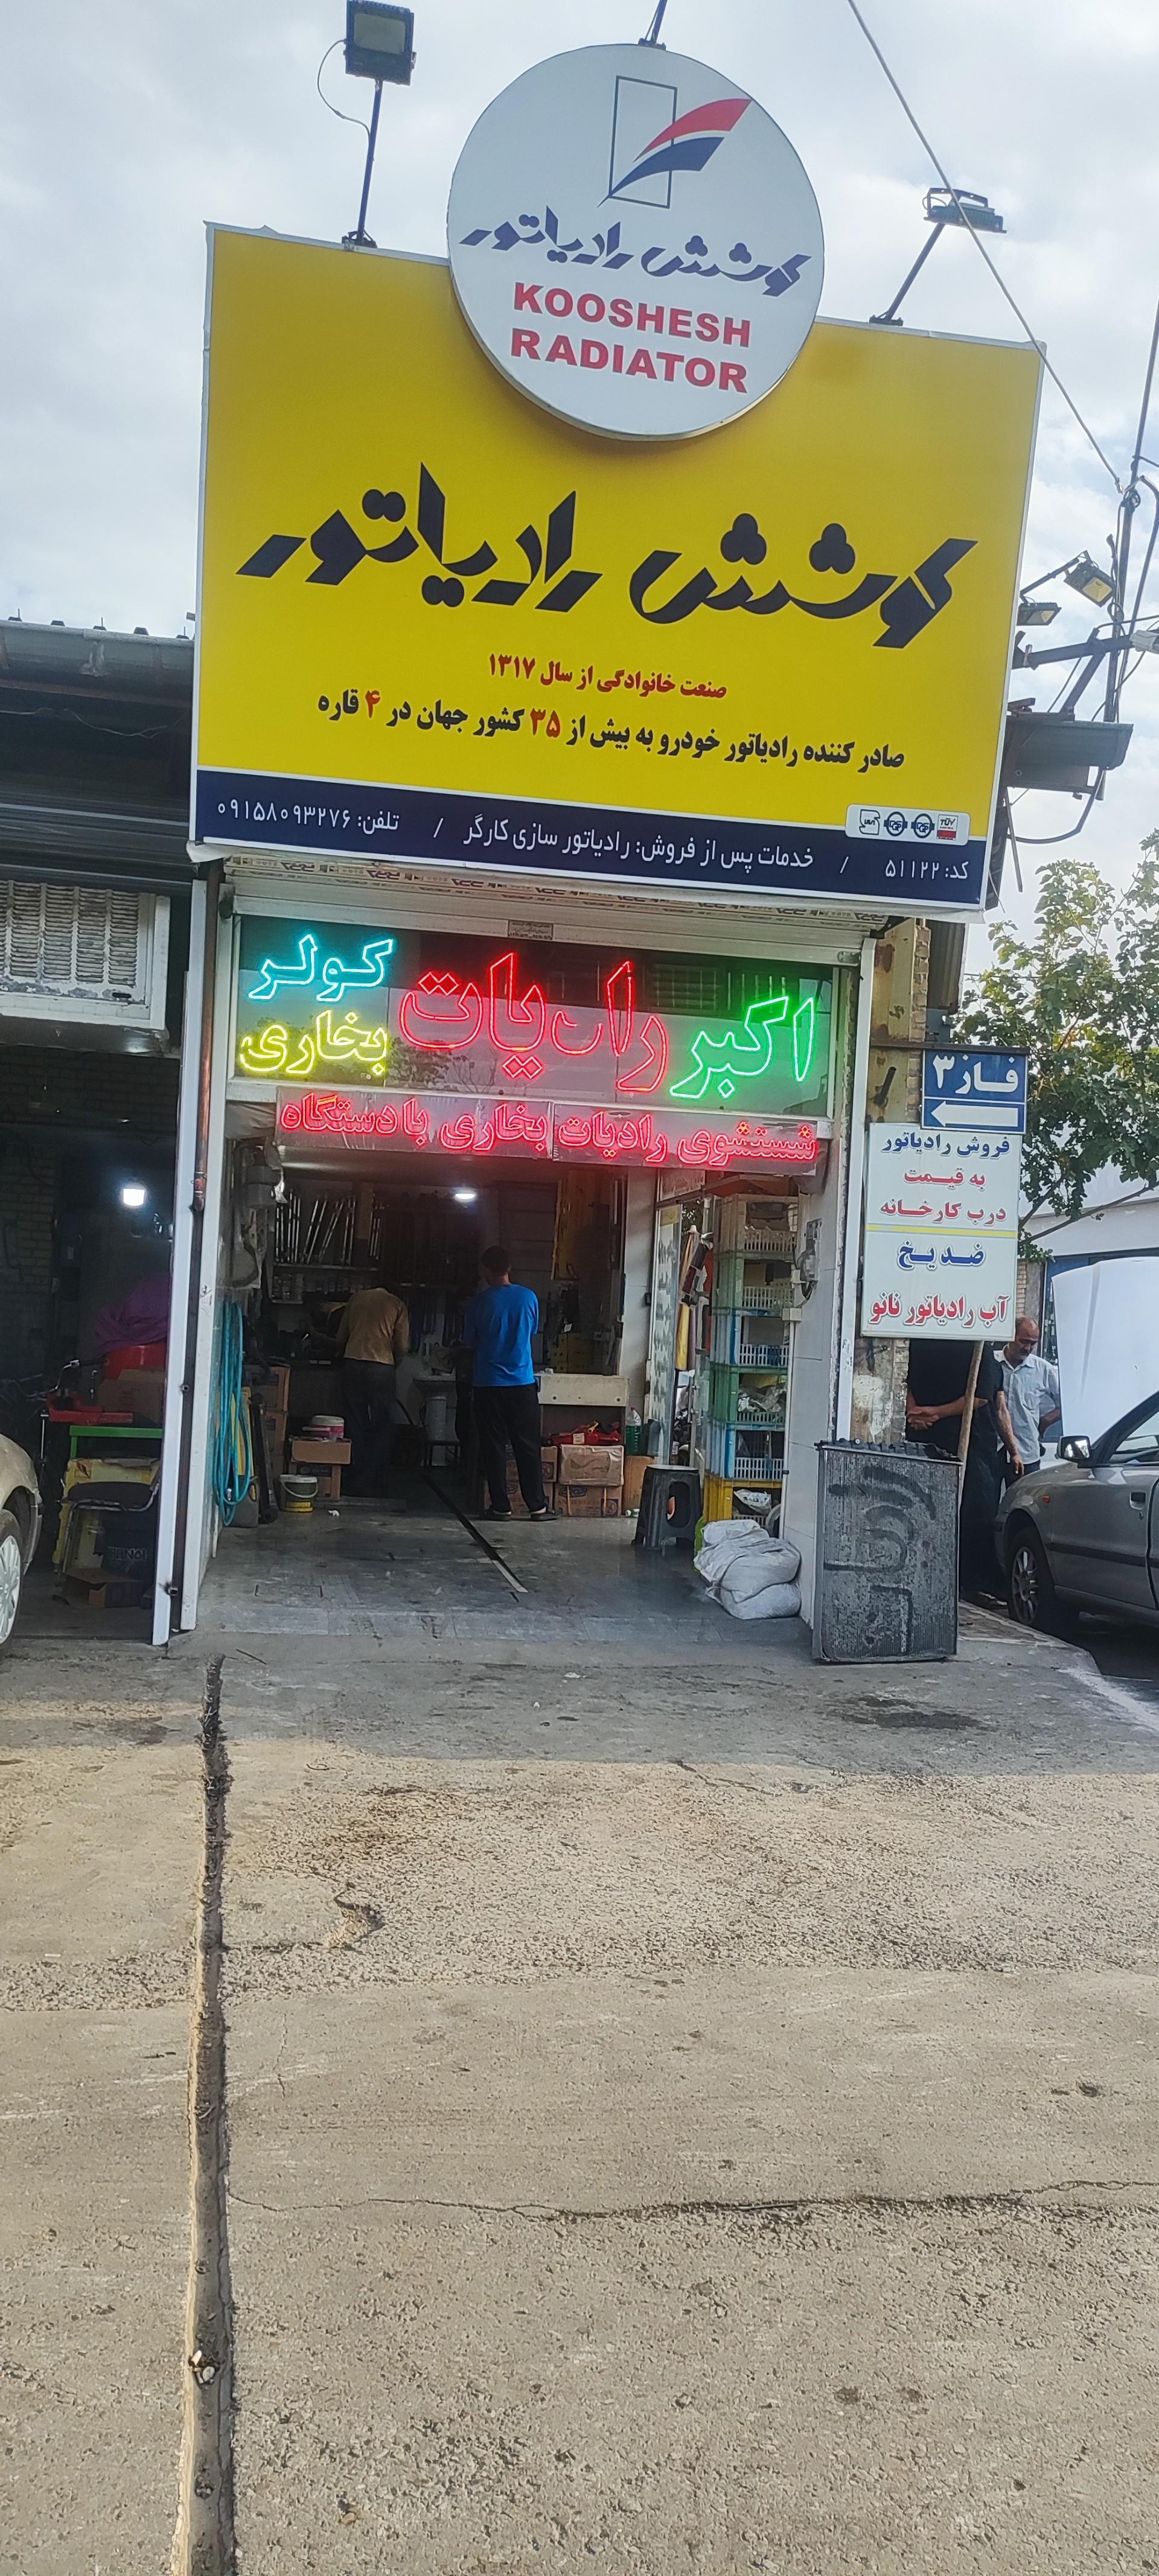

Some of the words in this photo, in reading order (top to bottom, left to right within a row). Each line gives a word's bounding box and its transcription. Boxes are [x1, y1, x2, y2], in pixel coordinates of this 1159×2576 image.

[459, 205, 634, 270] رادیاتور
[640, 235, 812, 297] کوشش
[512, 281, 751, 348] KOOSHESH
[510, 328, 749, 394] RADIATOR
[235, 461, 603, 613] رادیاتور
[630, 512, 979, 649] کوشش
[490, 654, 535, 679] ۱۳۱۷
[540, 661, 572, 686] سال
[576, 666, 593, 690] از
[597, 669, 676, 697] خانوادگی
[680, 680, 727, 698] صنعت
[318, 689, 359, 721] قاره
[365, 690, 380, 716] ۴
[386, 701, 411, 727] در
[417, 700, 468, 733] جهان
[473, 707, 525, 737] کشور
[530, 709, 561, 738] ۳۵
[566, 715, 586, 745] از
[590, 718, 630, 750] بیش
[636, 727, 653, 752] به
[657, 728, 720, 759] خودرو
[724, 733, 798, 767] رادیاتور
[803, 742, 855, 764] کننده
[858, 744, 905, 773] صادر
[218, 799, 351, 829] ۰۹۱۵۸۰۹۳۲۷۶
[357, 811, 400, 835] تلفن:
[463, 814, 508, 846] کارگر
[513, 823, 558, 850] سازی
[561, 829, 630, 859] رادیاتور
[636, 835, 695, 864] فروش:
[700, 839, 716, 867] از
[721, 851, 753, 874] پس
[758, 846, 813, 867] خدمات
[885, 859, 939, 879] ۵۱۱۲۲
[945, 861, 969, 879] کد:
[248, 933, 394, 1002] کولر
[240, 1009, 388, 1076] بخاری
[669, 996, 814, 1099] اکبر
[439, 1103, 548, 1152] بخاری
[558, 1111, 668, 1163] رادیات
[882, 1132, 951, 1155] رادیاتور
[957, 1137, 1010, 1158] فروش
[904, 1168, 964, 1188] قیمت
[969, 1173, 985, 1190] به
[880, 1199, 962, 1222] کارخانه
[967, 1208, 1006, 1224] درب
[898, 1241, 935, 1269] یخ
[940, 1244, 985, 1265] ضد
[869, 1293, 900, 1323] نانو
[905, 1295, 975, 1326] رادیاتور
[979, 1295, 1010, 1325] آب
